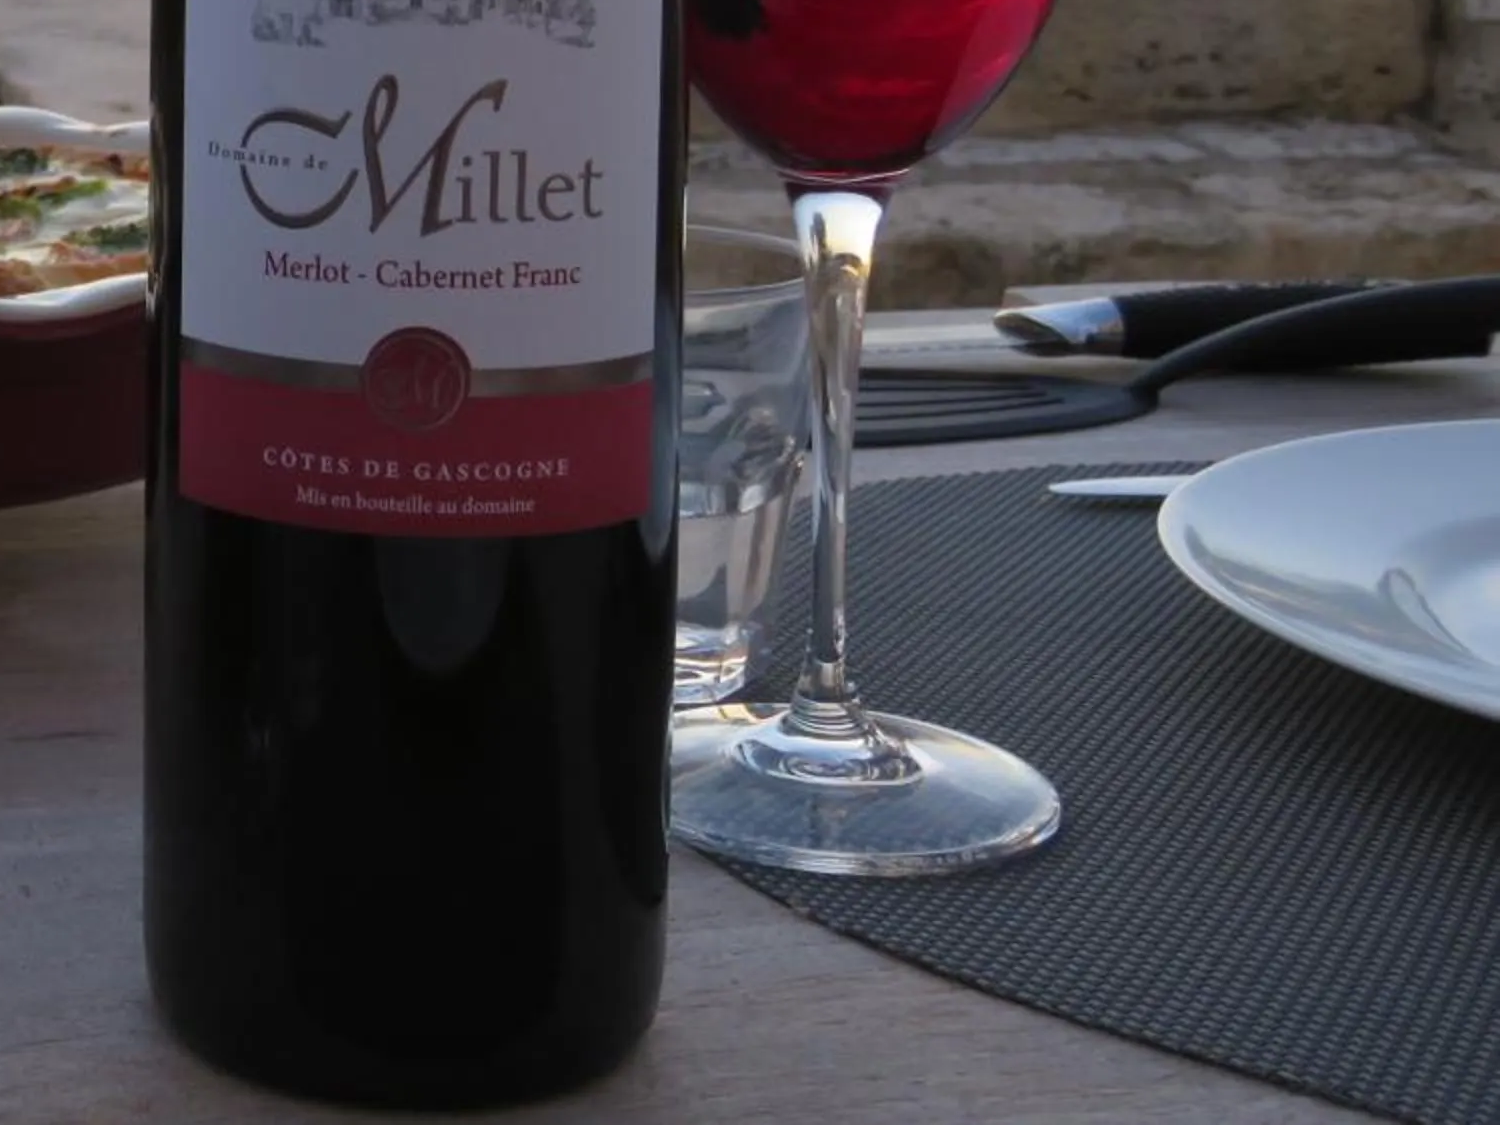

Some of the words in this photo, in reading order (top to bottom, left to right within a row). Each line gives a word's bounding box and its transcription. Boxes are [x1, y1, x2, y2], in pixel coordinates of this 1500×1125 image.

[208, 140, 292, 168] Domaine
[303, 153, 329, 171] de
[240, 73, 604, 237] Millet
[263, 249, 351, 284] Merlot
[375, 259, 504, 289] Cabernet
[511, 261, 582, 289] Franc
[262, 446, 351, 475] CÔTES
[364, 460, 399, 479] DE
[413, 457, 571, 482] GASCOGNE
[296, 484, 328, 507] Mis
[331, 492, 352, 510] en
[355, 490, 433, 515] bouteille
[436, 499, 457, 515] au
[461, 494, 536, 515] domaine
